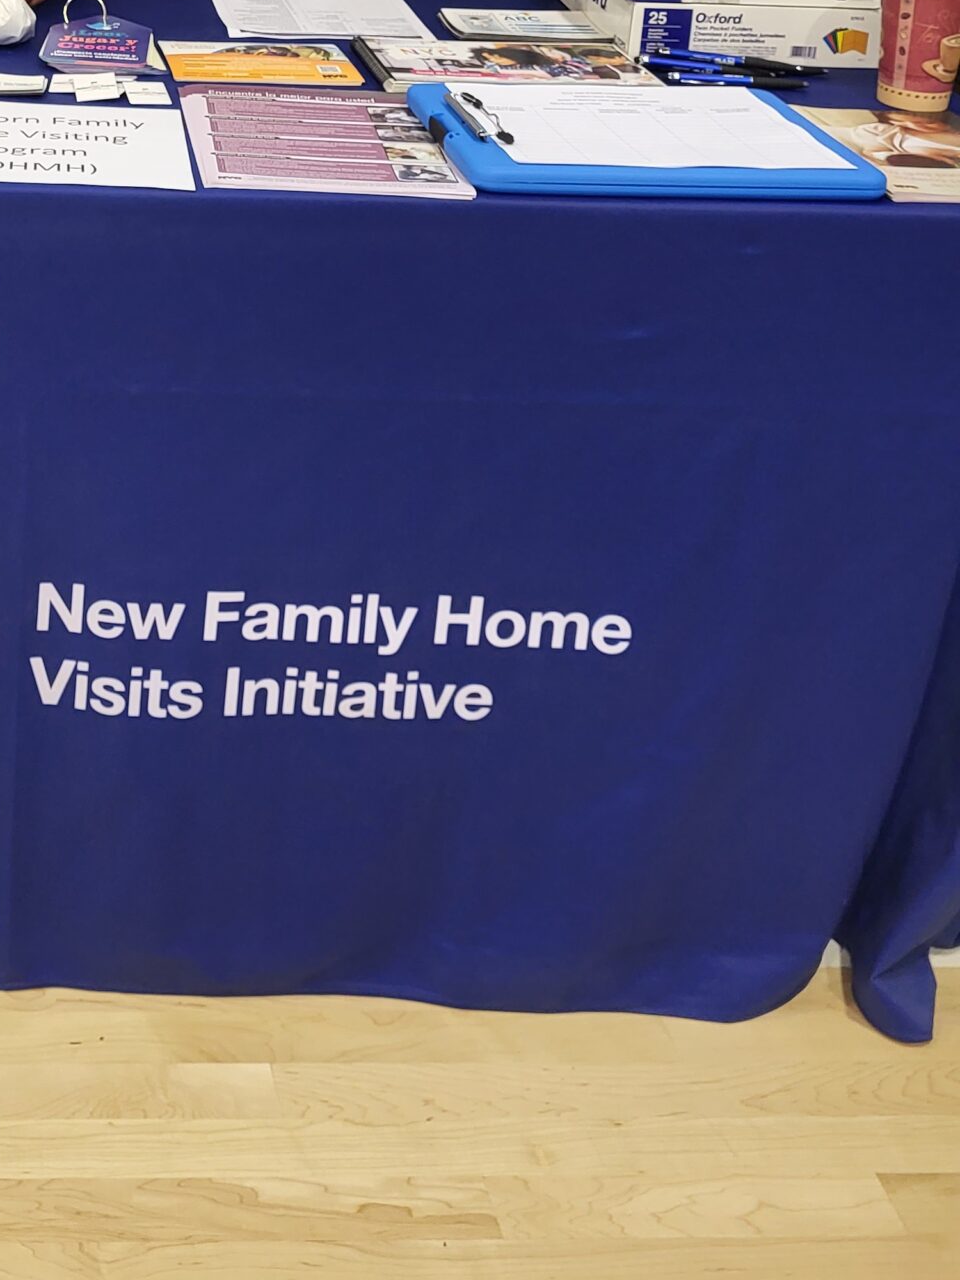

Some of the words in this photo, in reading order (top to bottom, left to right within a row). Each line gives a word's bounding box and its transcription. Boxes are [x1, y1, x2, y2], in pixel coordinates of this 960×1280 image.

[647, 11, 668, 25] 25
[695, 12, 744, 24] Oxford
[58, 35, 121, 44] Jugar
[52, 116, 145, 131] Family
[20, 130, 130, 146] Visiting
[36, 582, 186, 641] New
[202, 591, 419, 656] Family
[433, 594, 633, 655] Home
[28, 656, 205, 720] Visits
[223, 666, 495, 721] Initiative
